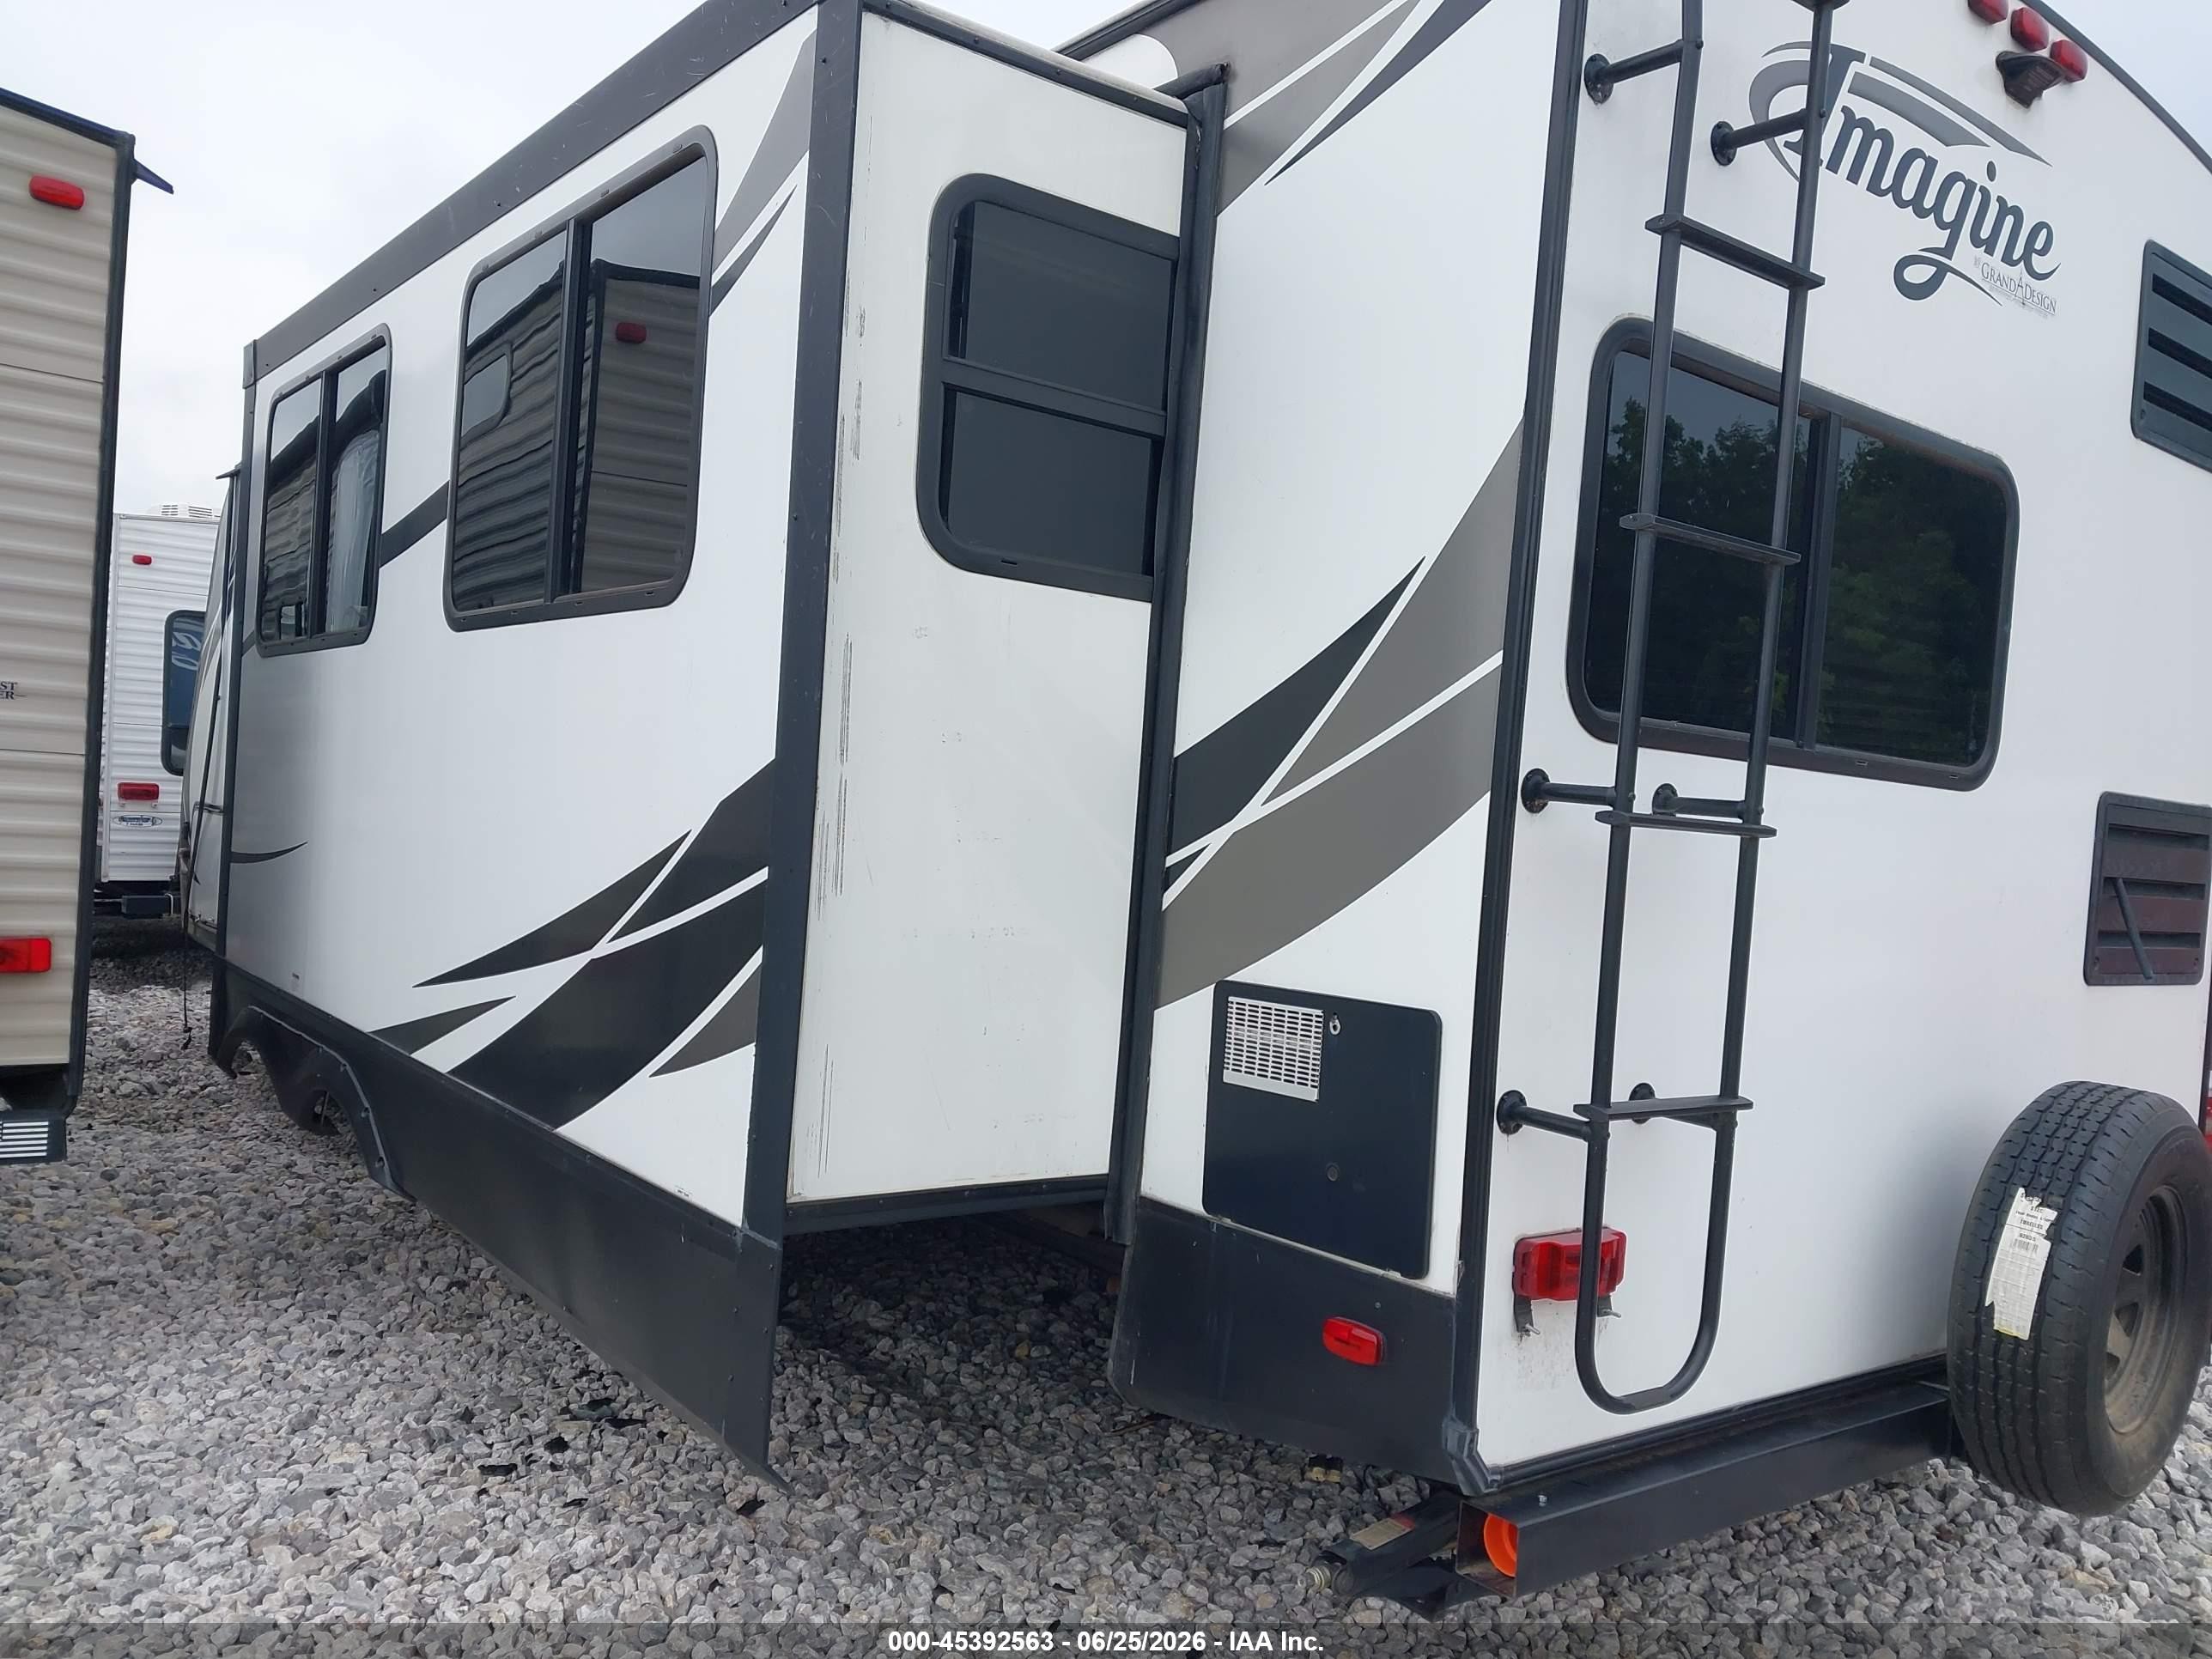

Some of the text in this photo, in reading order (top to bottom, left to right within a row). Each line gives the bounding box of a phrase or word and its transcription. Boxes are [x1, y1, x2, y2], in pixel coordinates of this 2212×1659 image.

[1765, 42, 2061, 305] Imagine
[1980, 262, 2017, 294] GRAND
[2024, 283, 2057, 313] DESIGN
